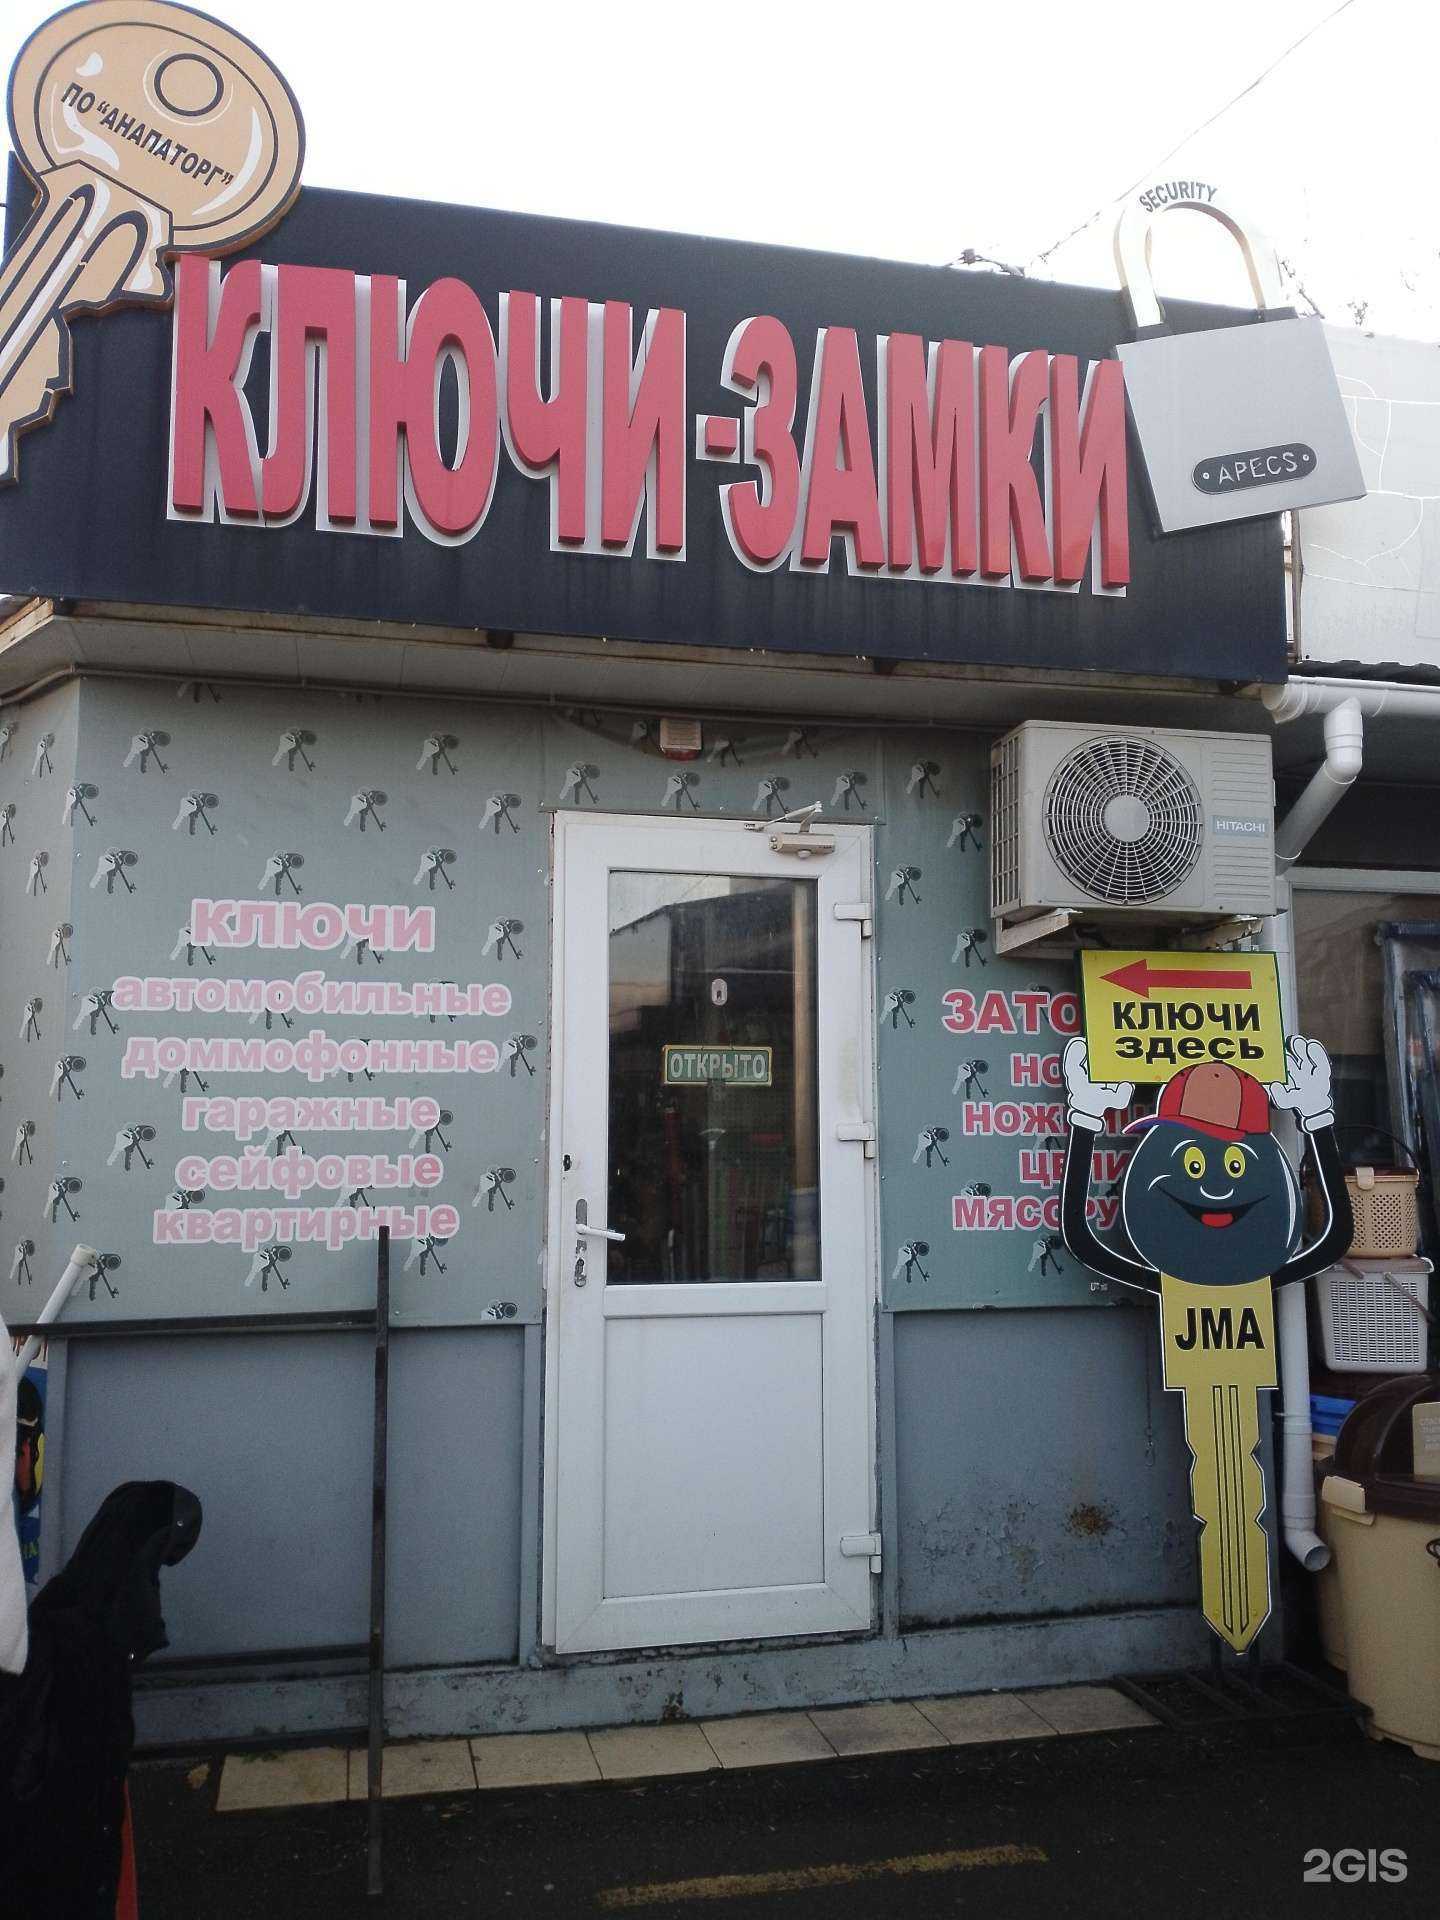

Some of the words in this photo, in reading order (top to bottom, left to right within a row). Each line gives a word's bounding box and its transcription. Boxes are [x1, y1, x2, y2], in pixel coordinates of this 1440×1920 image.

[61, 82, 96, 114] ПО
[1139, 181, 1218, 213] SECURITY
[1218, 451, 1298, 486] APECS
[1215, 820, 1266, 833] HITACHI
[111, 971, 512, 1016] автомобильные
[122, 1030, 500, 1082] доммофонные
[670, 1053, 766, 1079] ОТКРЫТО
[182, 1096, 440, 1139] гаражные
[175, 1146, 443, 1198] сейфовые
[153, 1204, 459, 1251] квартирные
[1174, 1307, 1265, 1351] JMA
